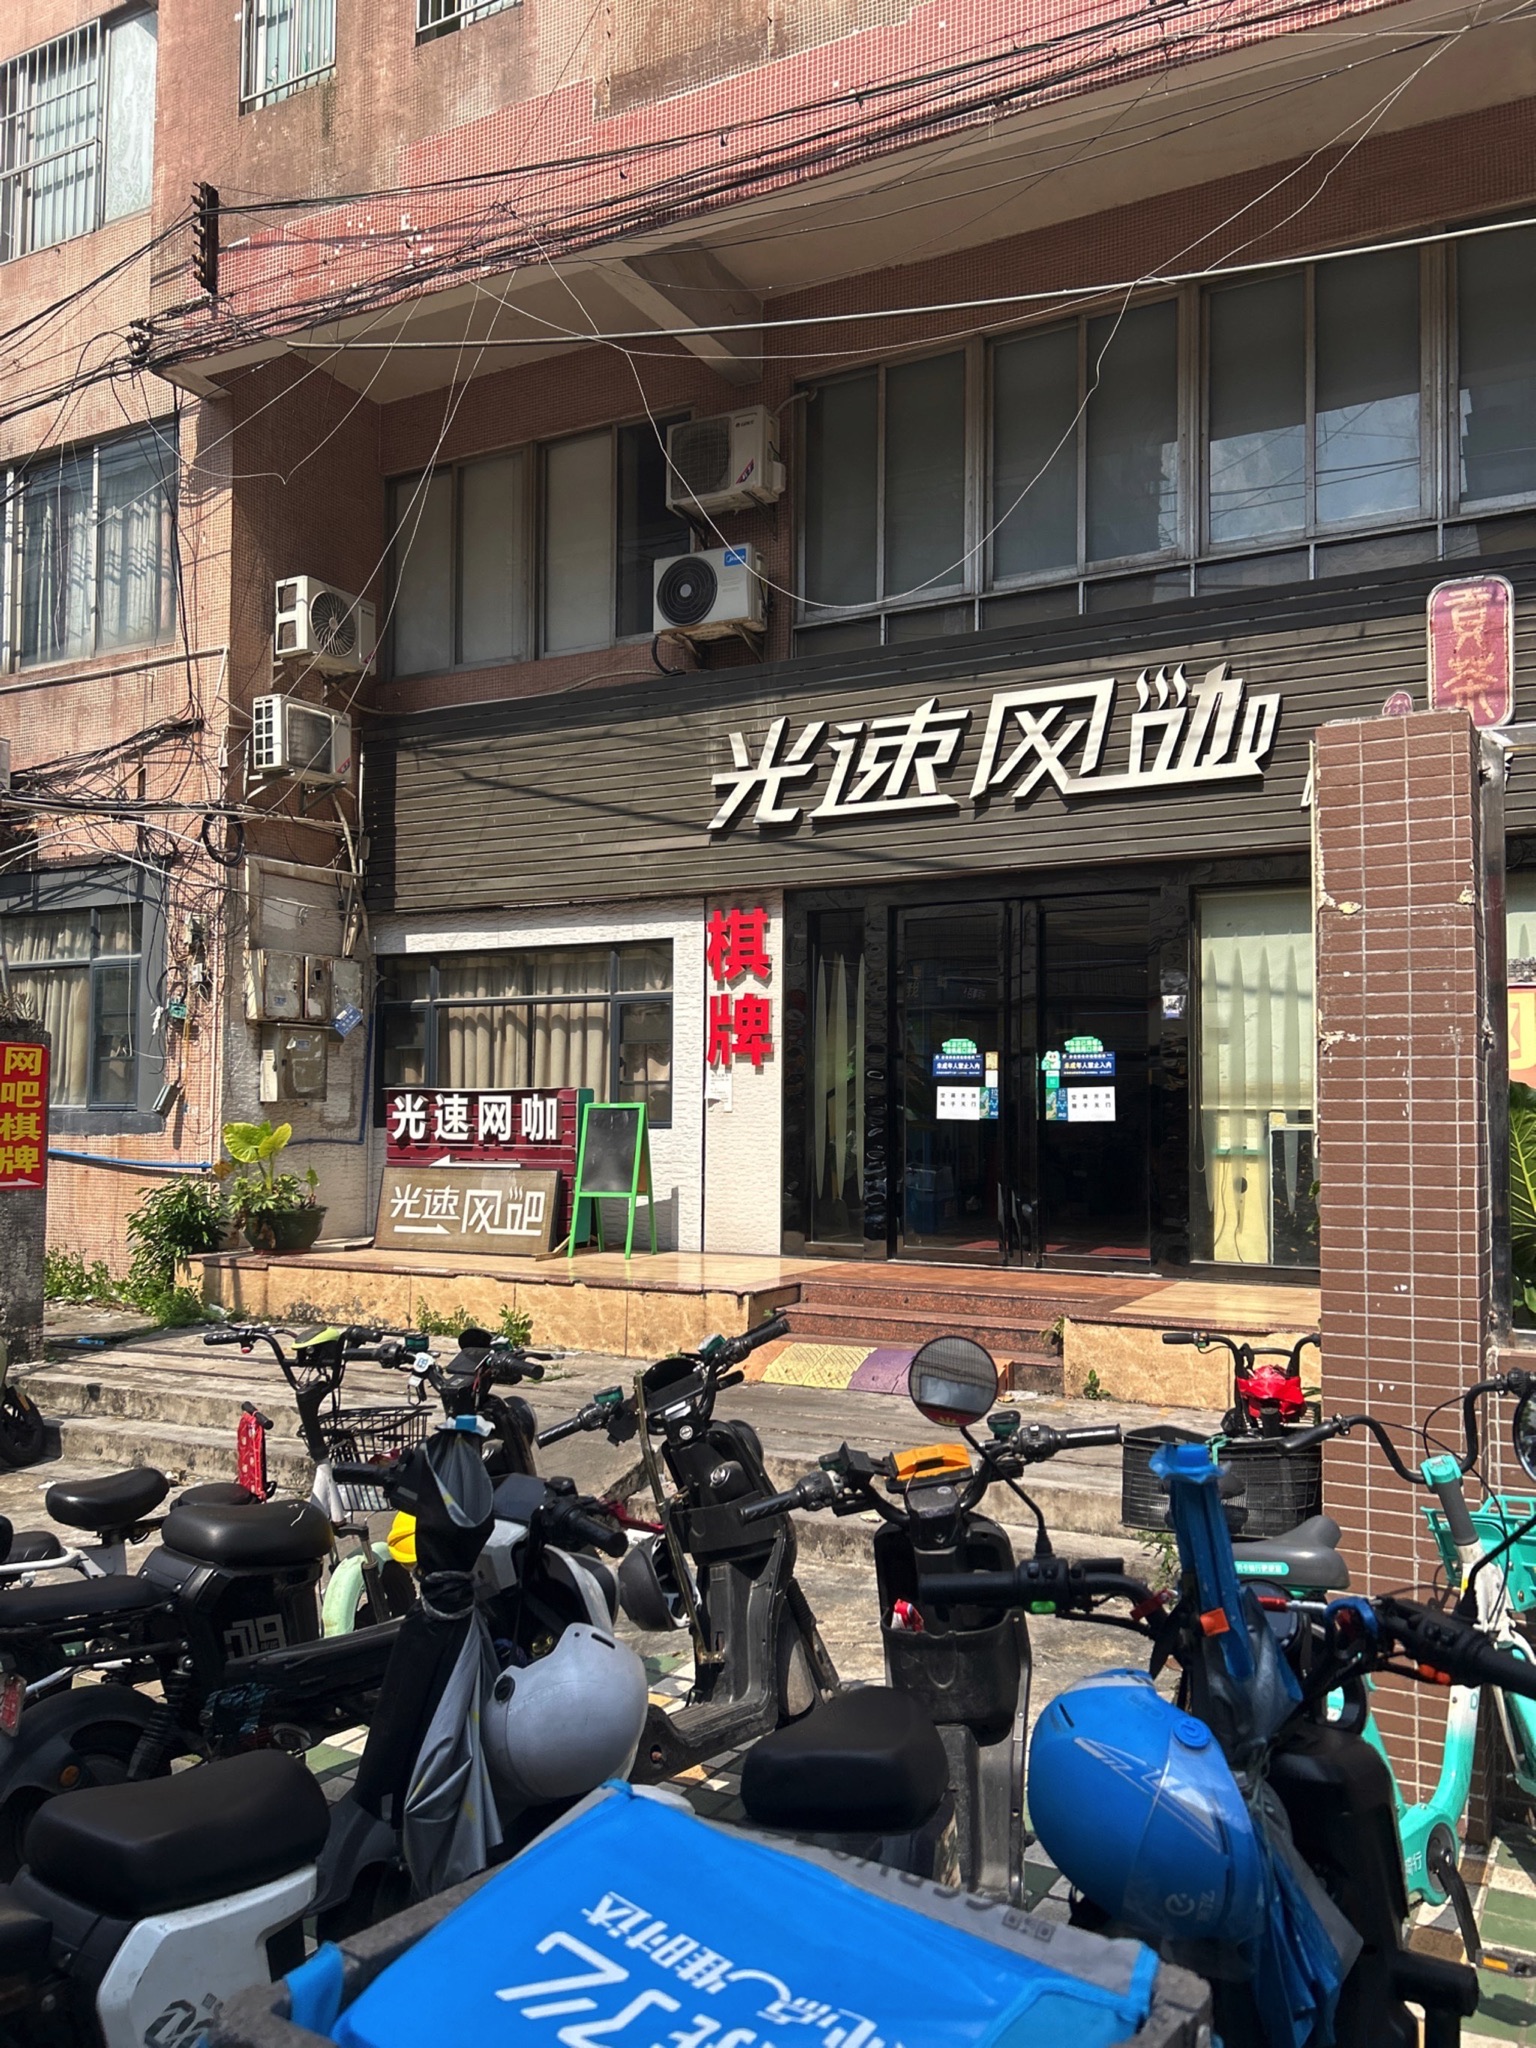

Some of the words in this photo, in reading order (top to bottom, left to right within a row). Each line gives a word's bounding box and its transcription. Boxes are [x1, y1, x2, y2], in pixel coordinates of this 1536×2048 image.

[706, 662, 1281, 829] 光速网咖
[706, 906, 774, 1066] 棋牌
[0, 1046, 43, 1174] 网吧棋牌
[391, 1092, 559, 1142] 光速网咖
[390, 1184, 546, 1236] 光速网吧
[581, 1891, 734, 1997] 准时达
